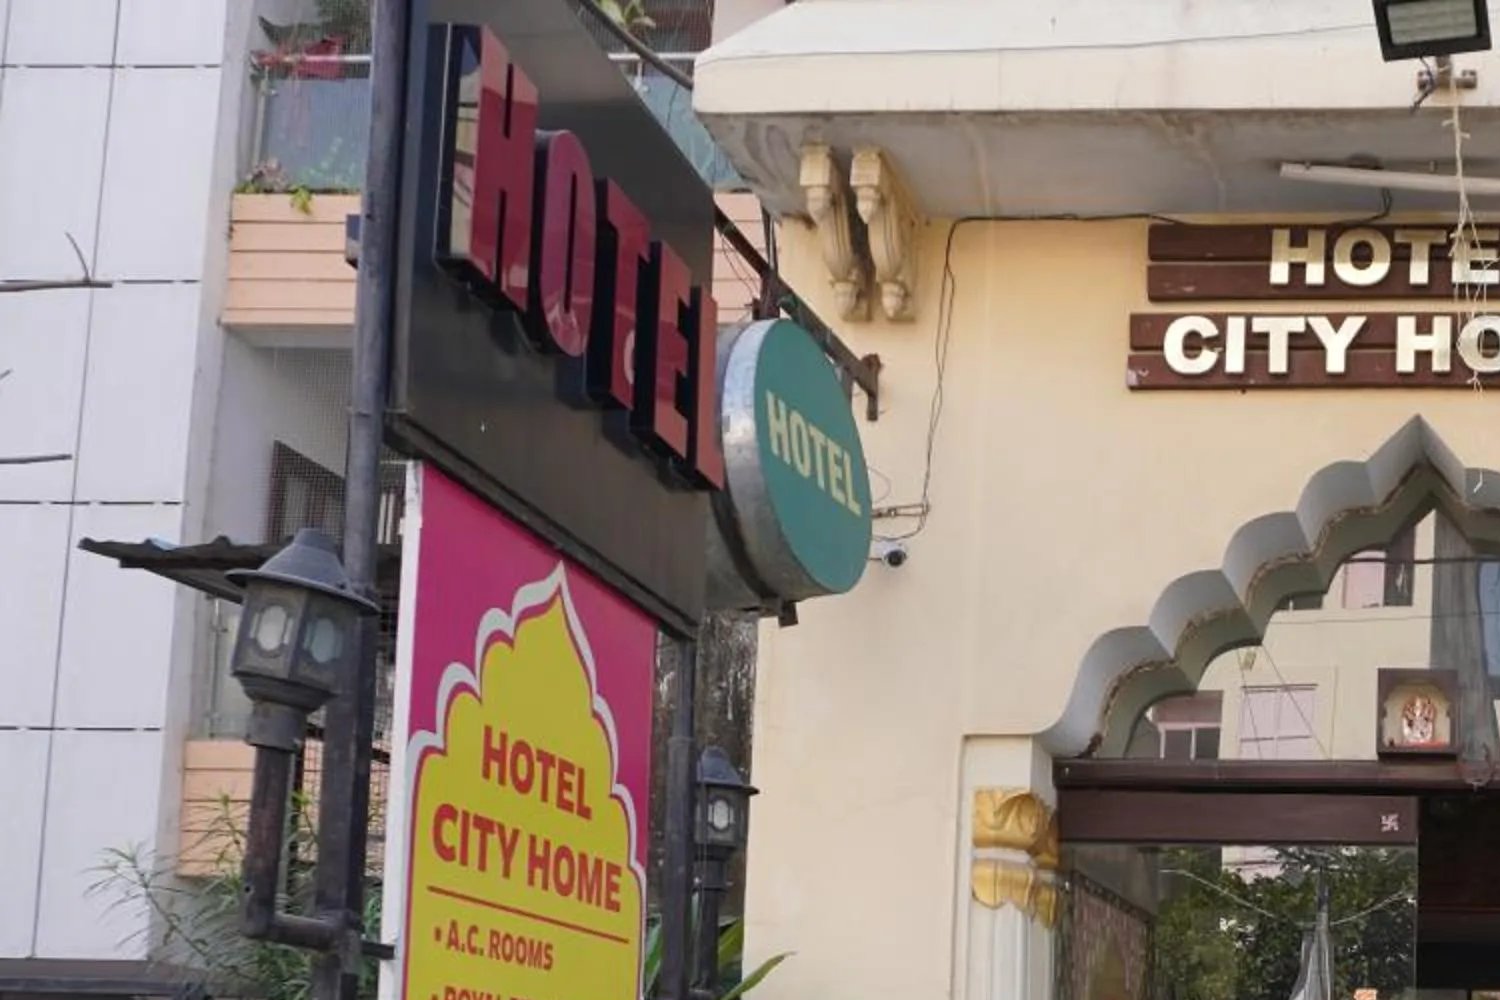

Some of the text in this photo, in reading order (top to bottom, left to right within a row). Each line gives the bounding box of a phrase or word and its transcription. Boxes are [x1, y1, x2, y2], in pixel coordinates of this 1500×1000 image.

[1163, 314, 1367, 375] CITY
[766, 388, 862, 517] HOTEL
[482, 723, 593, 821] HOTEL
[432, 803, 622, 912] CITY HOME
[447, 919, 554, 971] A.C. ROOMS
